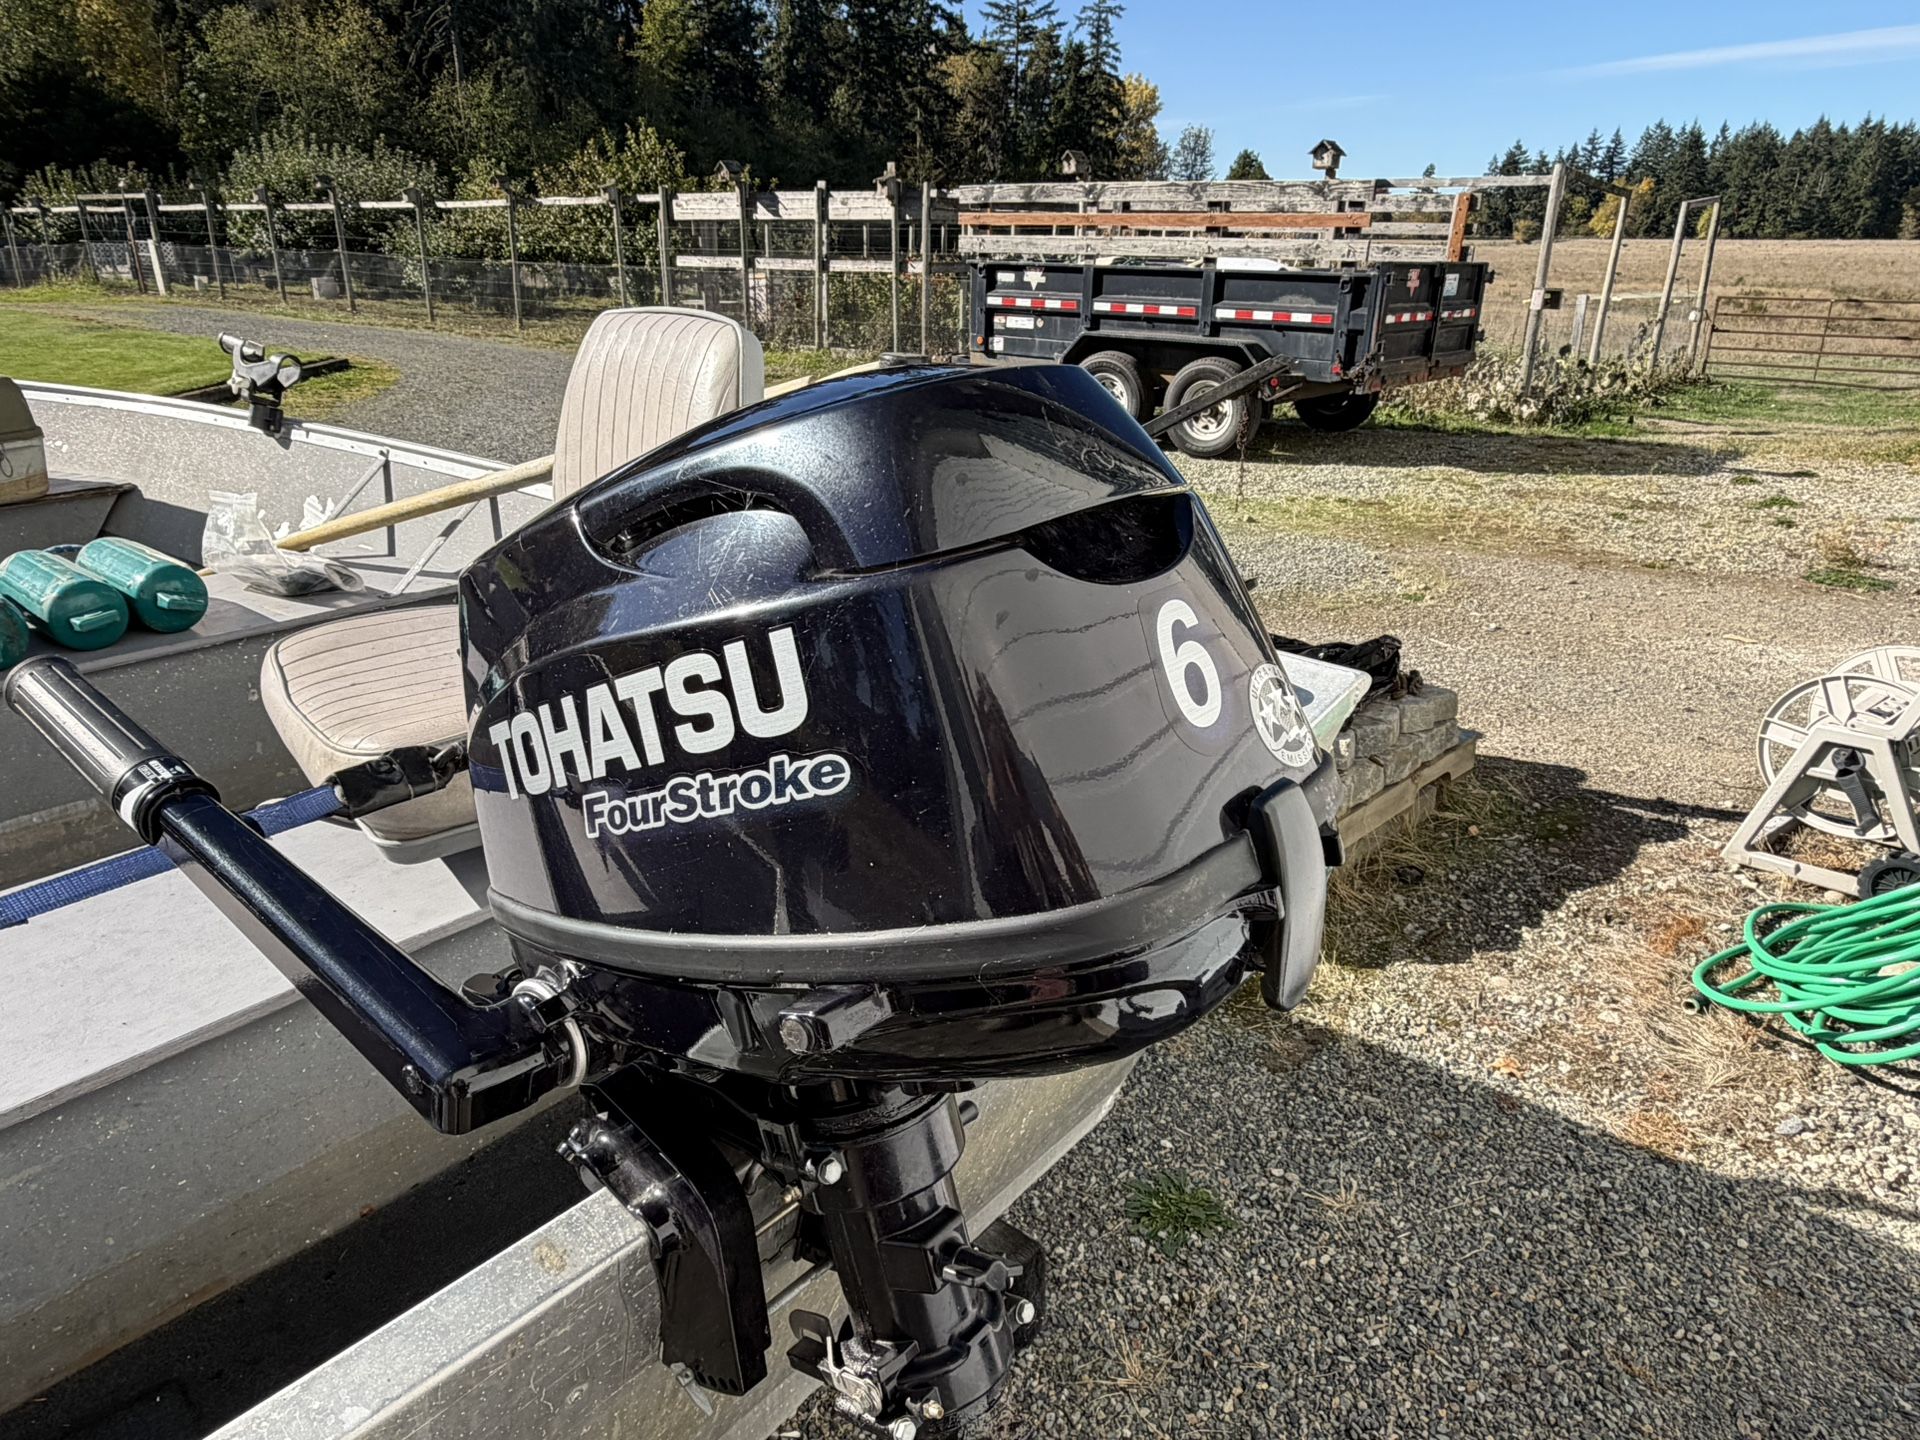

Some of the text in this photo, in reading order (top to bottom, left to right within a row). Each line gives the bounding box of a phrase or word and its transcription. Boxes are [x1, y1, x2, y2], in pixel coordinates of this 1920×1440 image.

[488, 627, 808, 800] TOHATSU
[1157, 599, 1222, 728] 6
[583, 754, 851, 839] FourStroke
